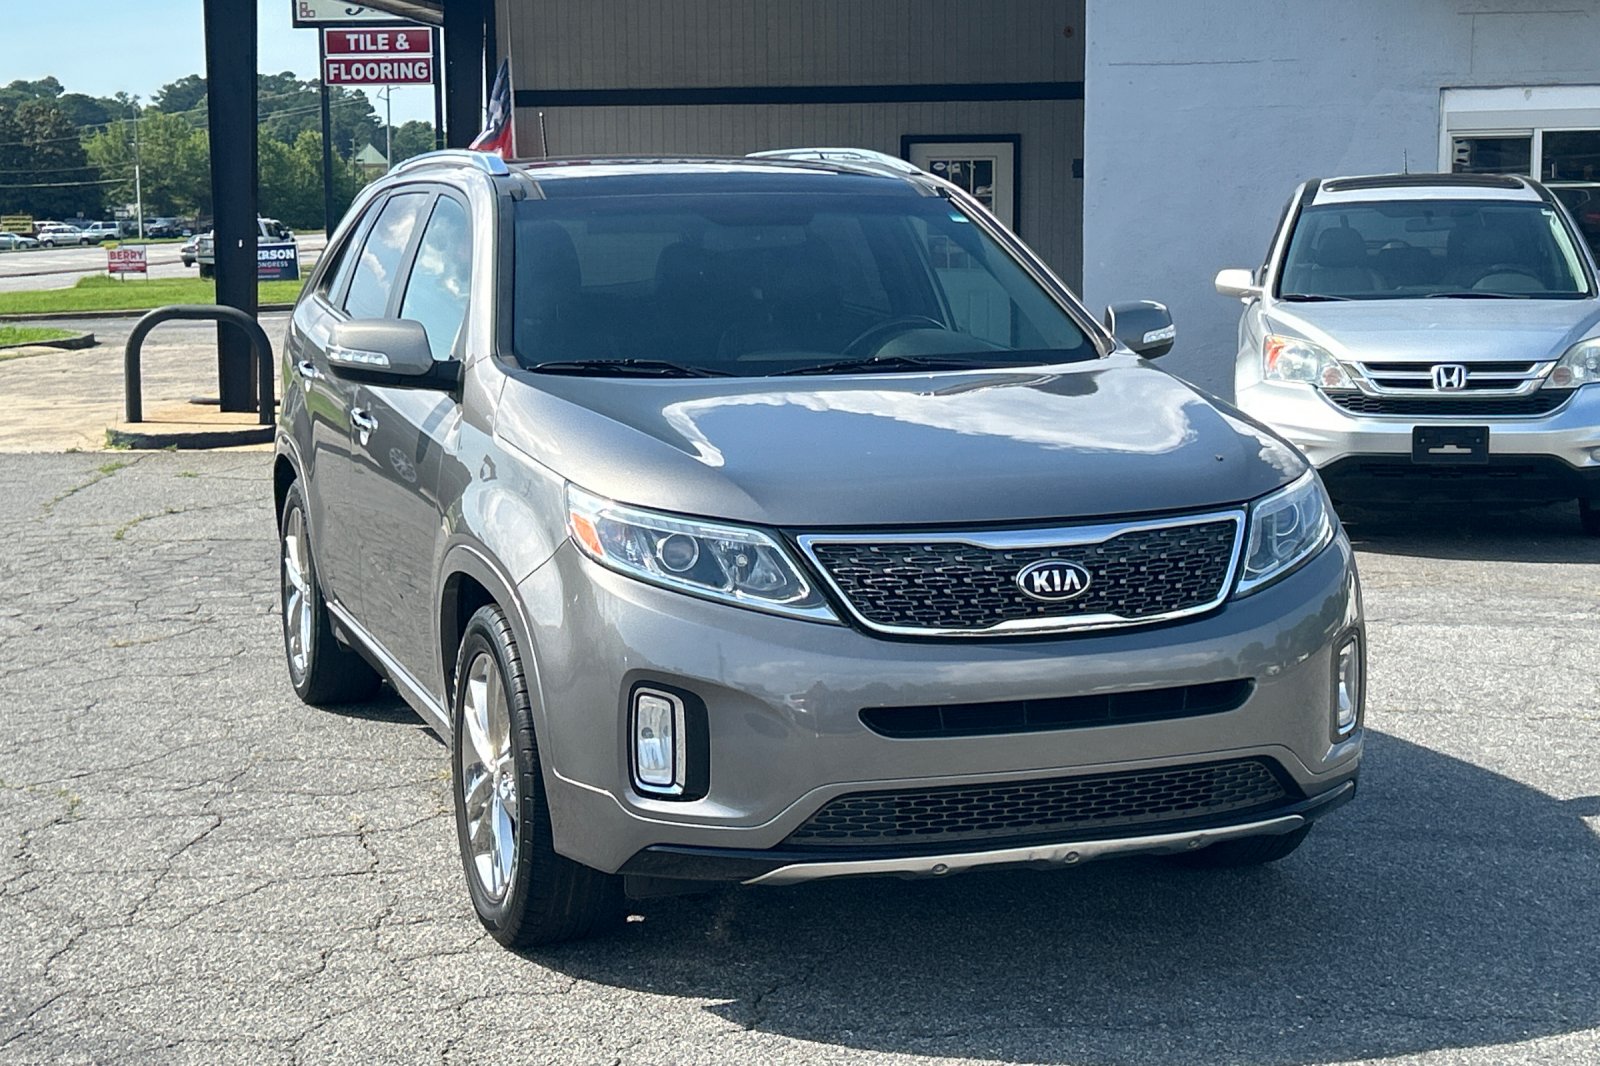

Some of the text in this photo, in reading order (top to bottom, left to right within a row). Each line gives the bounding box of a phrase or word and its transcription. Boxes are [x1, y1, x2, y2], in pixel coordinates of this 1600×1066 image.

[345, 33, 410, 51] TILE &
[328, 61, 429, 80] FLOORING
[110, 250, 144, 260] BERRY
[1031, 569, 1081, 593] KIA
